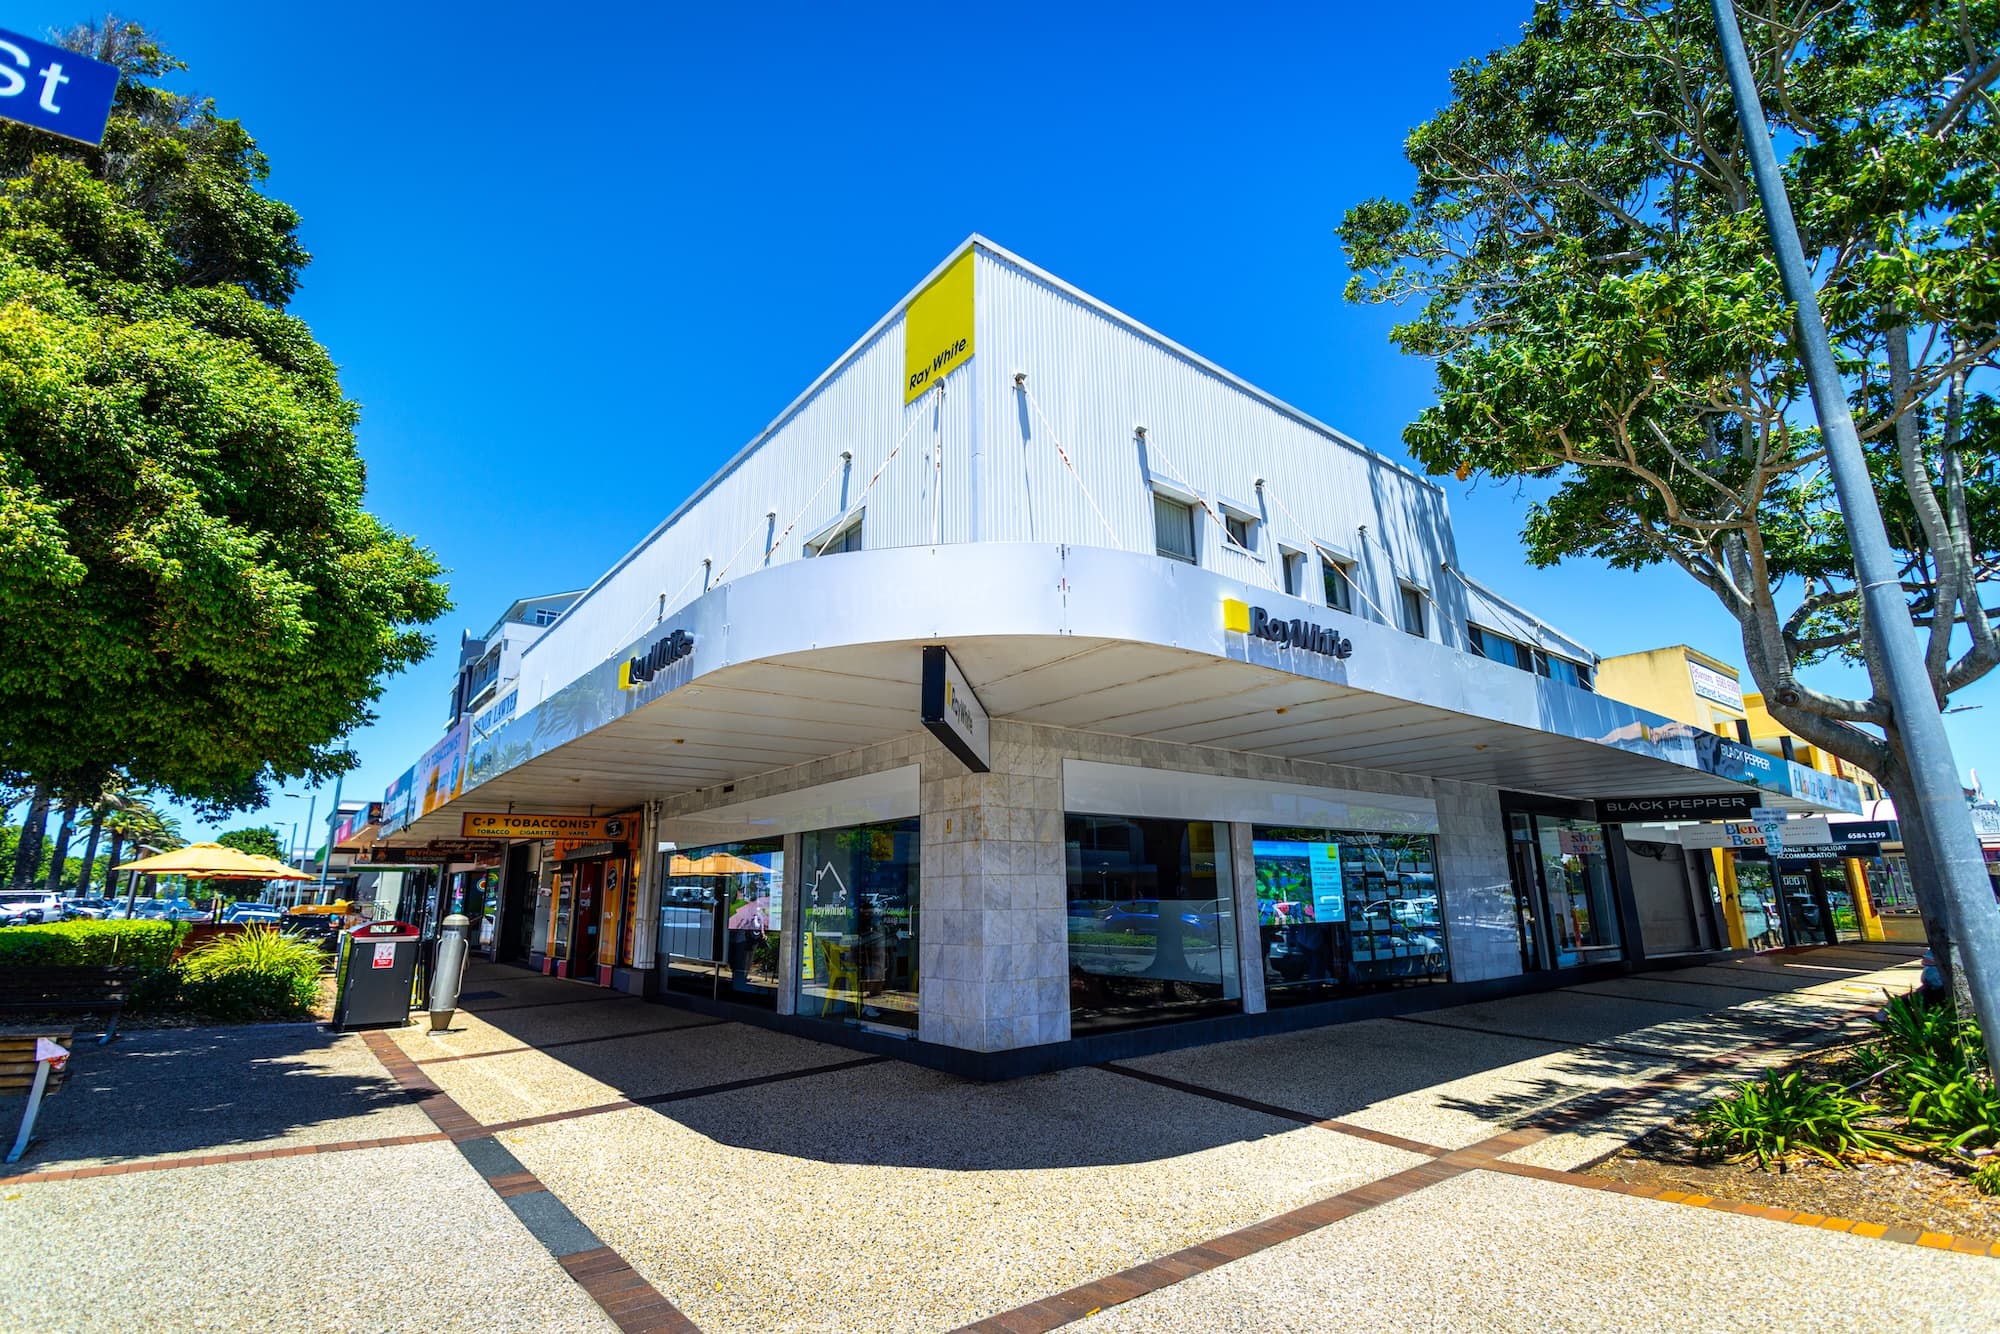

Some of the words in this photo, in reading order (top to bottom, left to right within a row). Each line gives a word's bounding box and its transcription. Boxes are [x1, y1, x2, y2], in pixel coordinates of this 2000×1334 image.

[0, 40, 70, 114] St
[909, 364, 932, 391] Ray
[1719, 743, 1744, 762] BLACK
[1743, 751, 1771, 771] PEPPER
[1606, 800, 1664, 812] BLACK
[1668, 797, 1746, 809] PEPPER
[503, 818, 598, 829] TOBACCONIST
[1724, 823, 1764, 835] Blen
[1764, 823, 1778, 833] 2P
[1732, 835, 1767, 846] Bea
[1867, 831, 1886, 839] 1199
[1816, 844, 1847, 852] HOLIDAY
